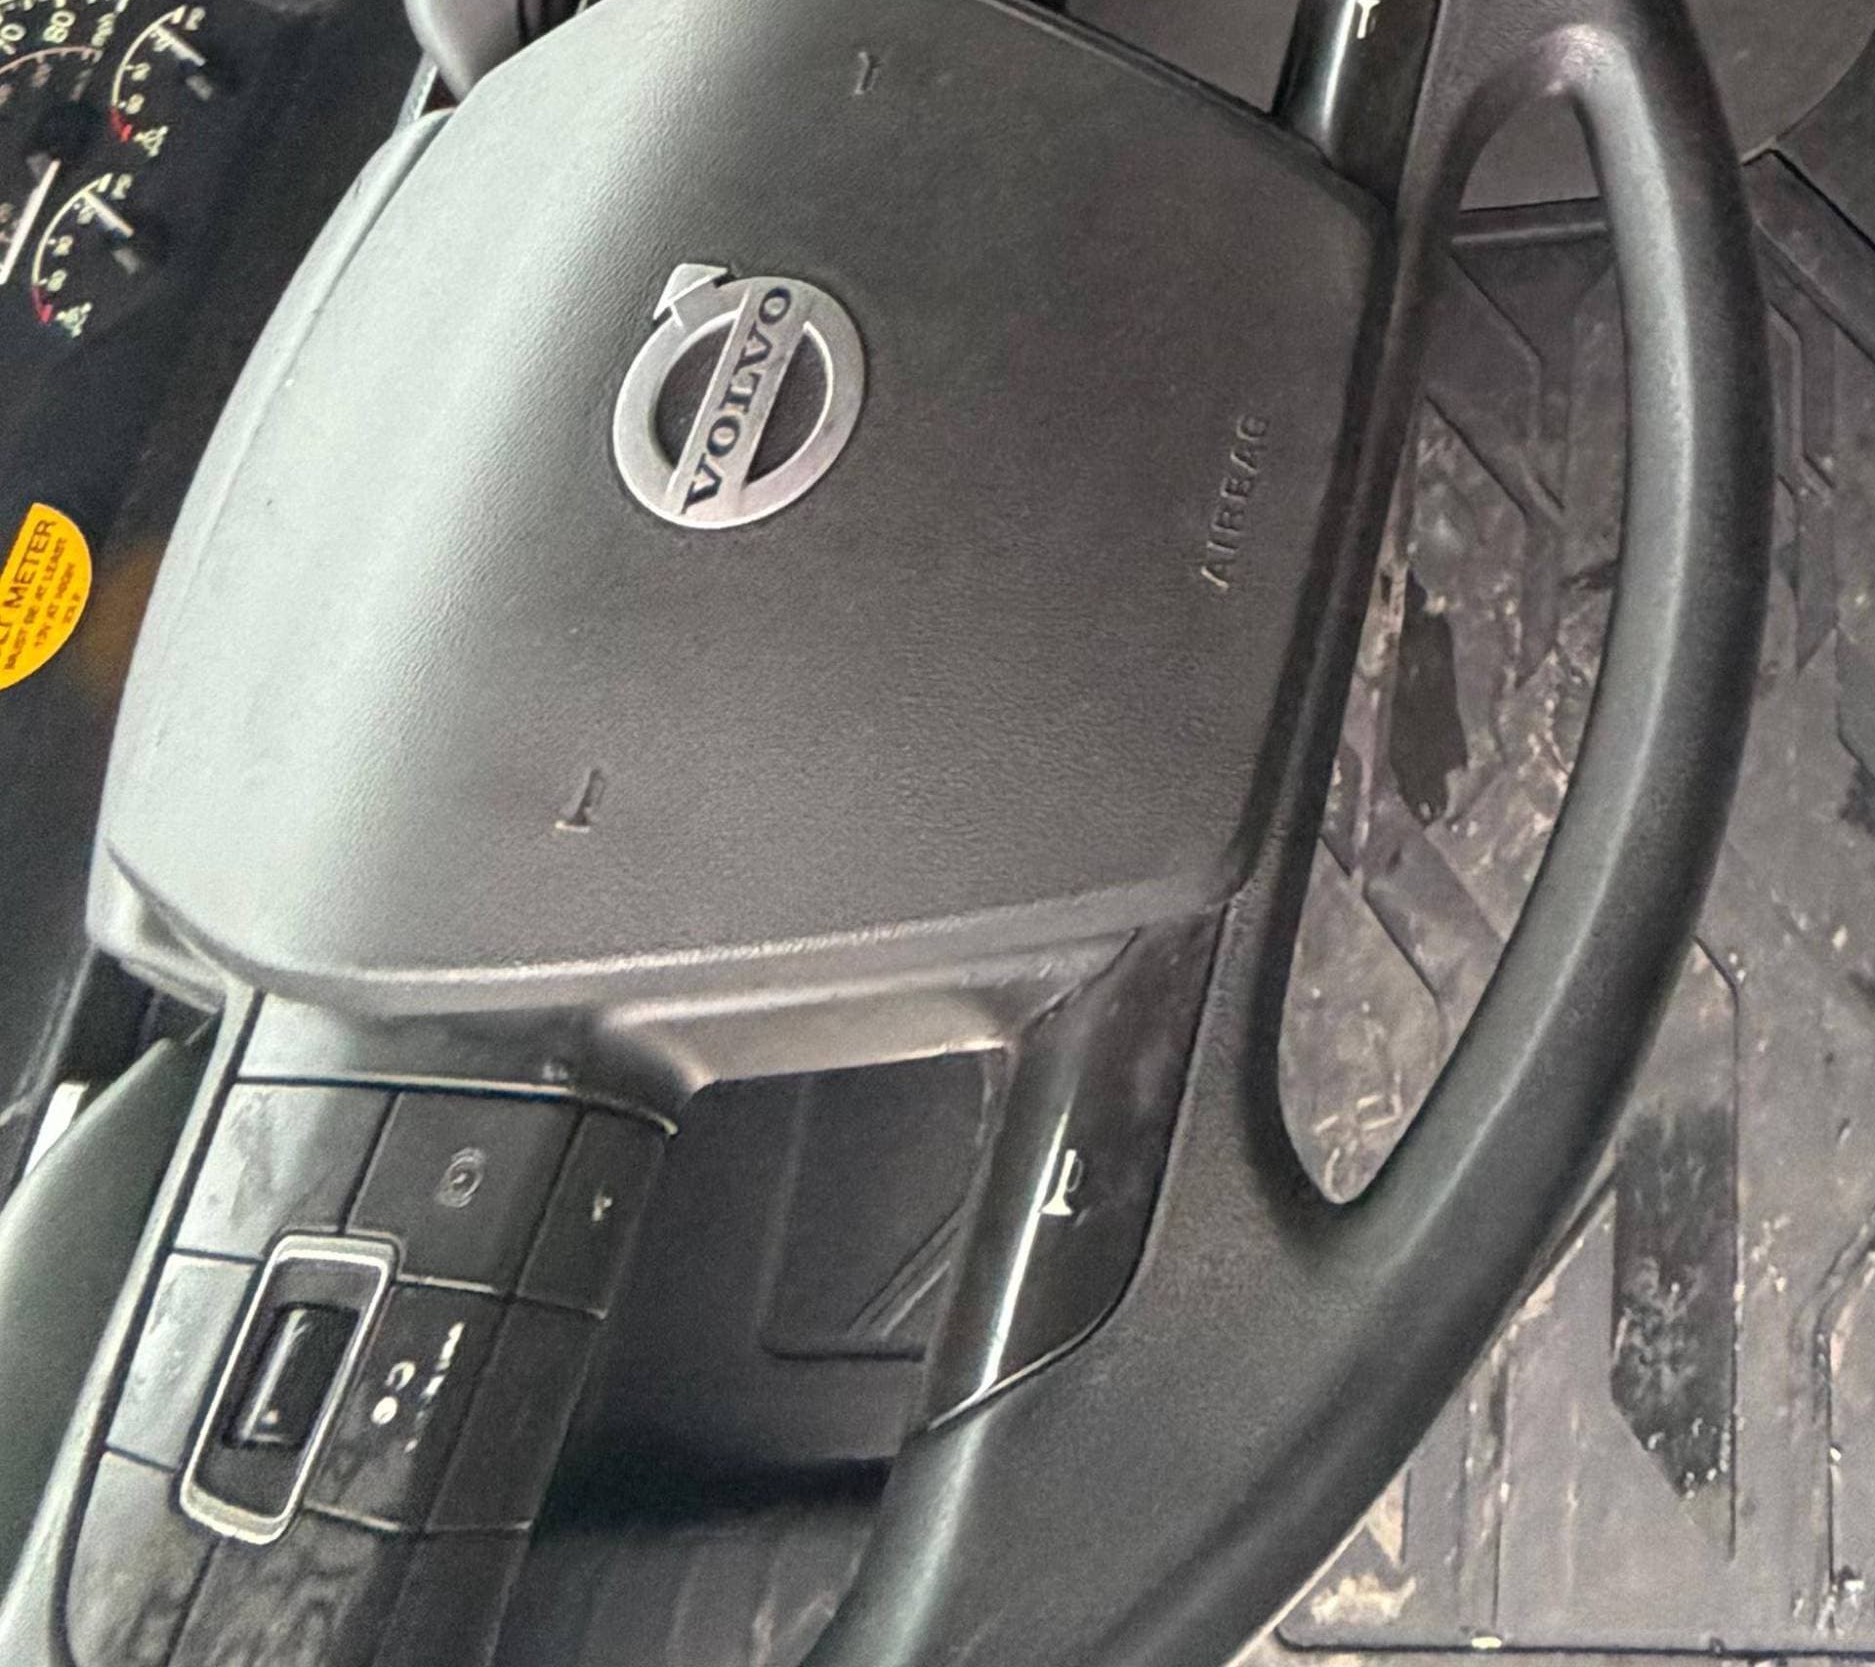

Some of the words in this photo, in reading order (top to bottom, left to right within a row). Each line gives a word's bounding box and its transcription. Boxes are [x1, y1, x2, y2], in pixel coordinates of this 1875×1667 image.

[43, 10, 76, 44] 80
[681, 286, 792, 515] VOLVO
[3, 520, 56, 608] METER
[1200, 414, 1270, 589] AIRBAG
